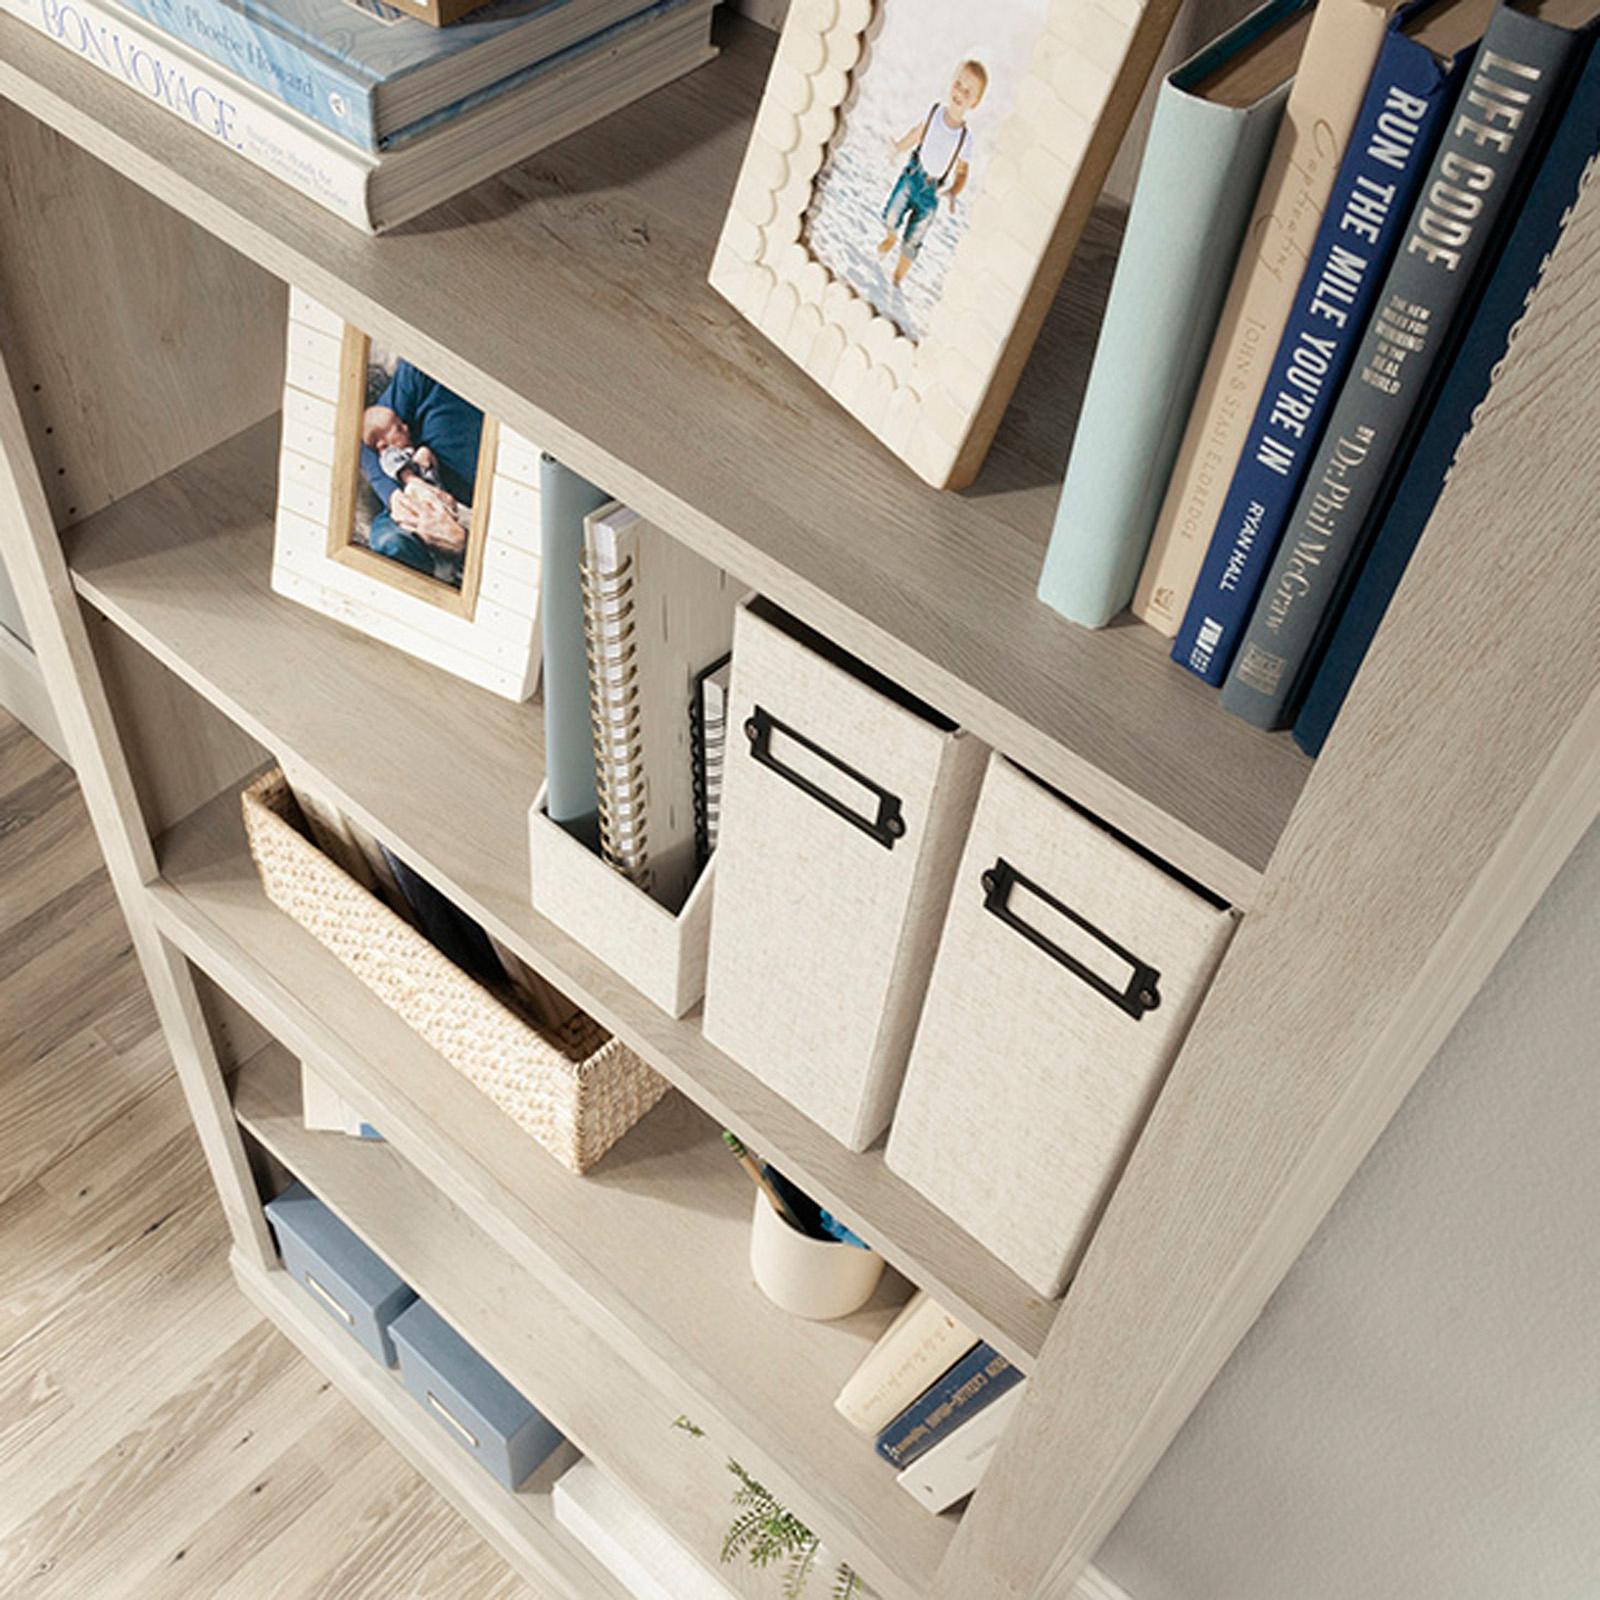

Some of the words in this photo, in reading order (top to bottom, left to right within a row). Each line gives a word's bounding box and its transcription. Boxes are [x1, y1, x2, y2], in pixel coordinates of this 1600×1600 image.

[1366, 86, 1429, 170] RUN
[1454, 49, 1542, 154] LIFE
[1253, 118, 1338, 282] Captivating
[1340, 175, 1397, 244] THE
[1407, 151, 1496, 272] CODE
[1310, 244, 1368, 328] MILE
[1269, 331, 1337, 439] YOU'RE
[1256, 435, 1296, 476] IN
[1236, 500, 1265, 551] RYAN
[1305, 476, 1351, 537] Phil
[1220, 548, 1248, 592] HALL
[1264, 540, 1328, 635] McGraw
